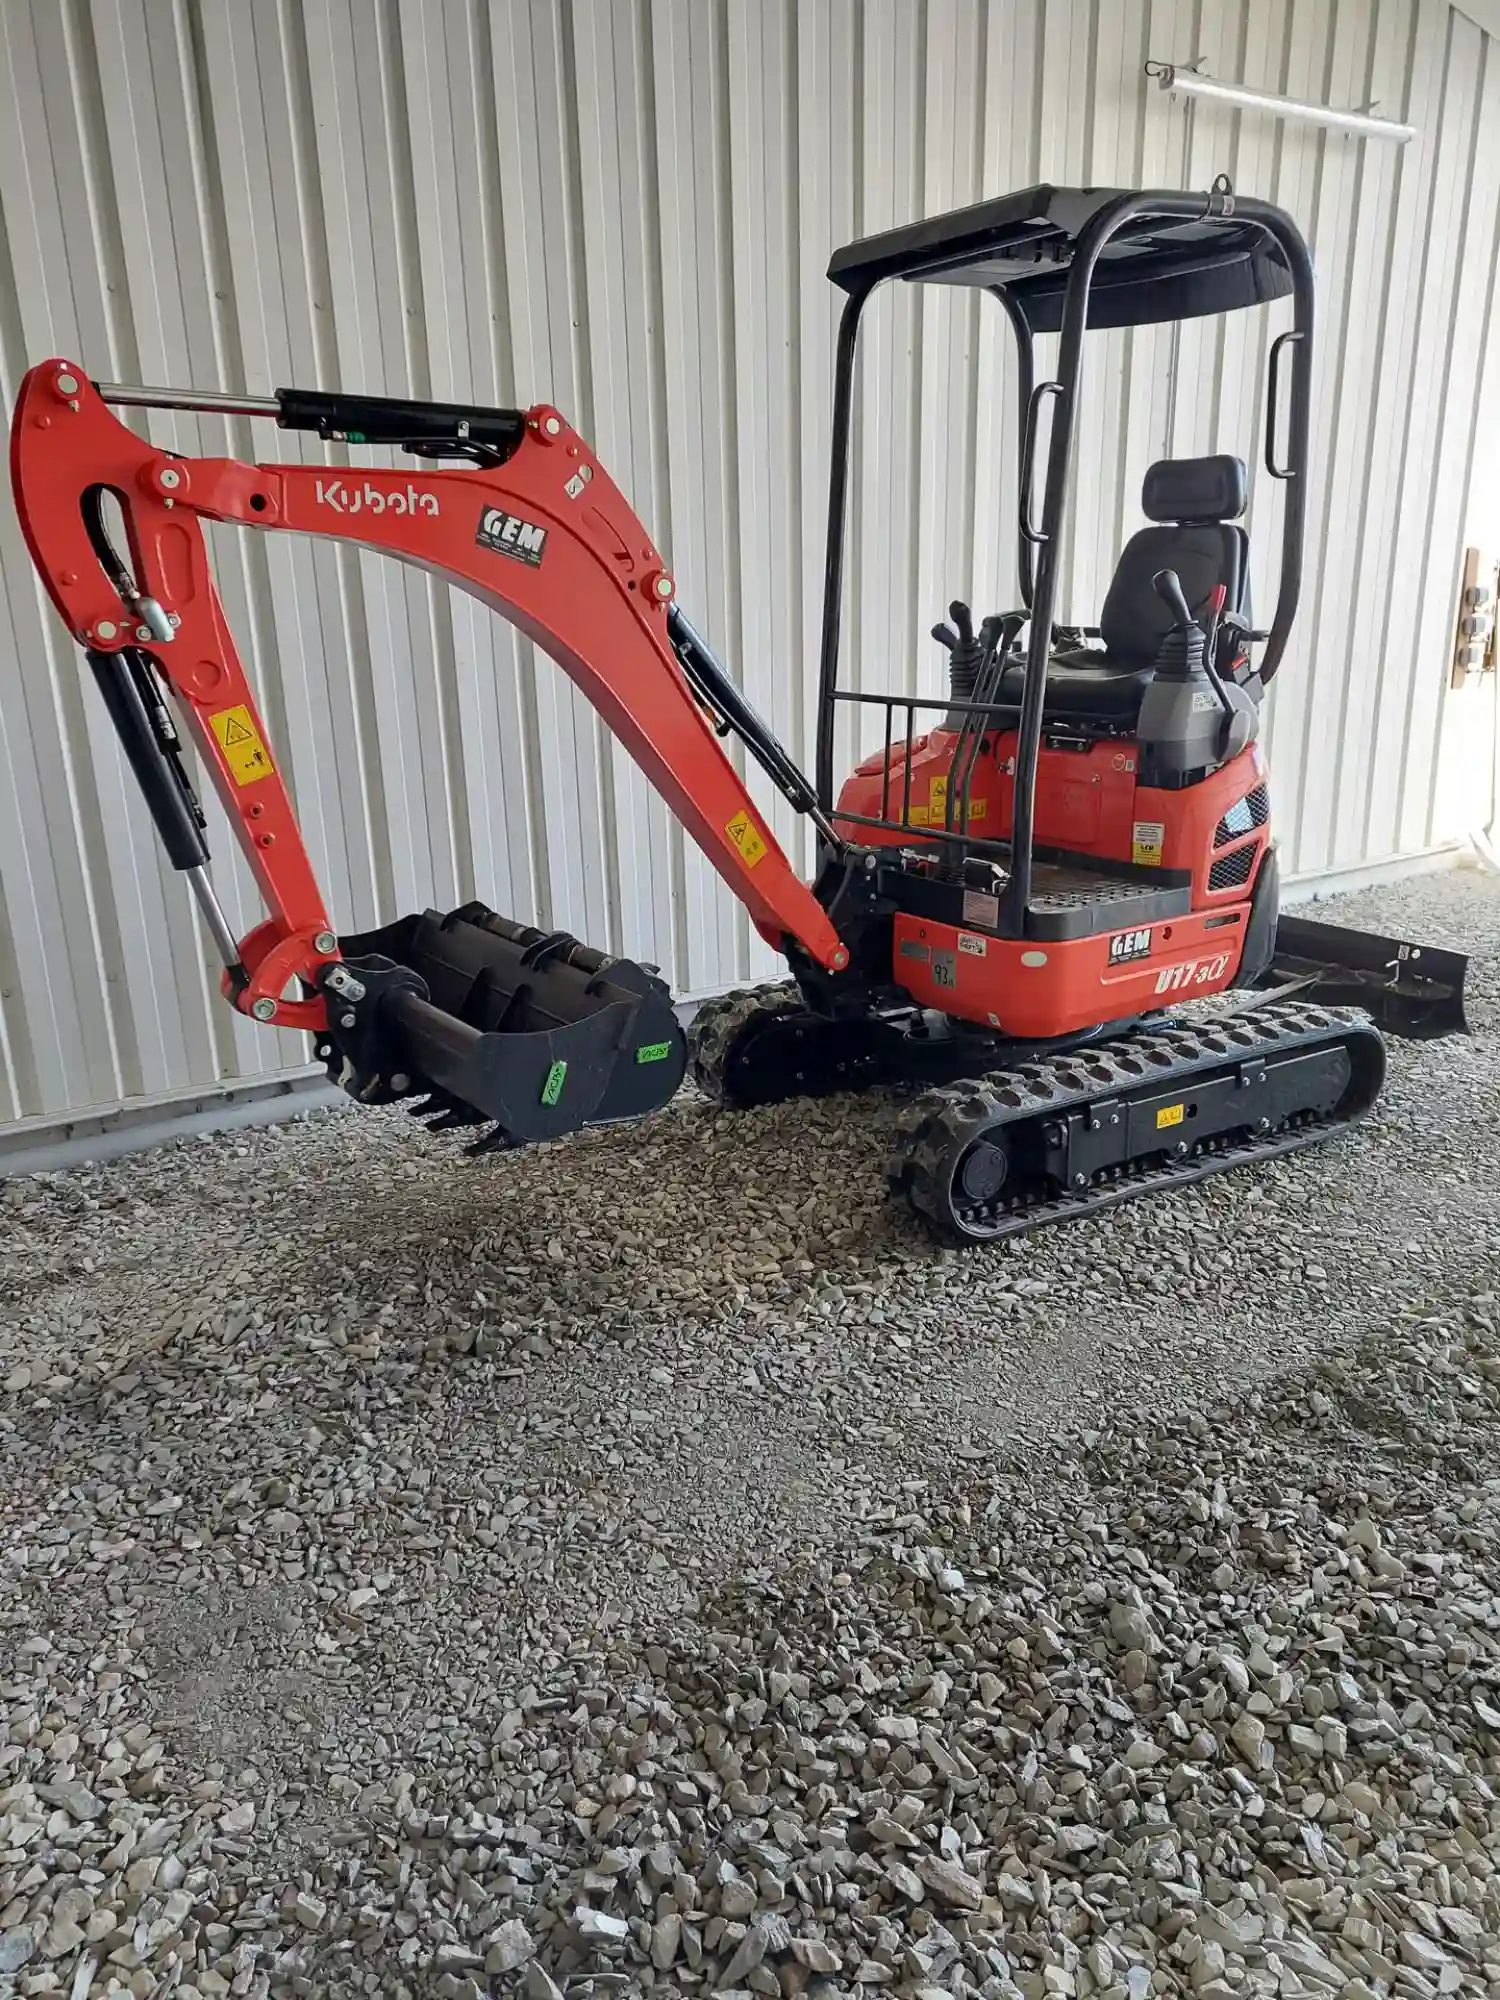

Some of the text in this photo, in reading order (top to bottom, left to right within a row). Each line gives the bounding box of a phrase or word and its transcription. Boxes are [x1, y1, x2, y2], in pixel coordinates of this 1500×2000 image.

[315, 480, 440, 516] Kubota
[483, 508, 546, 553] GEM
[1111, 928, 1151, 956] GEM
